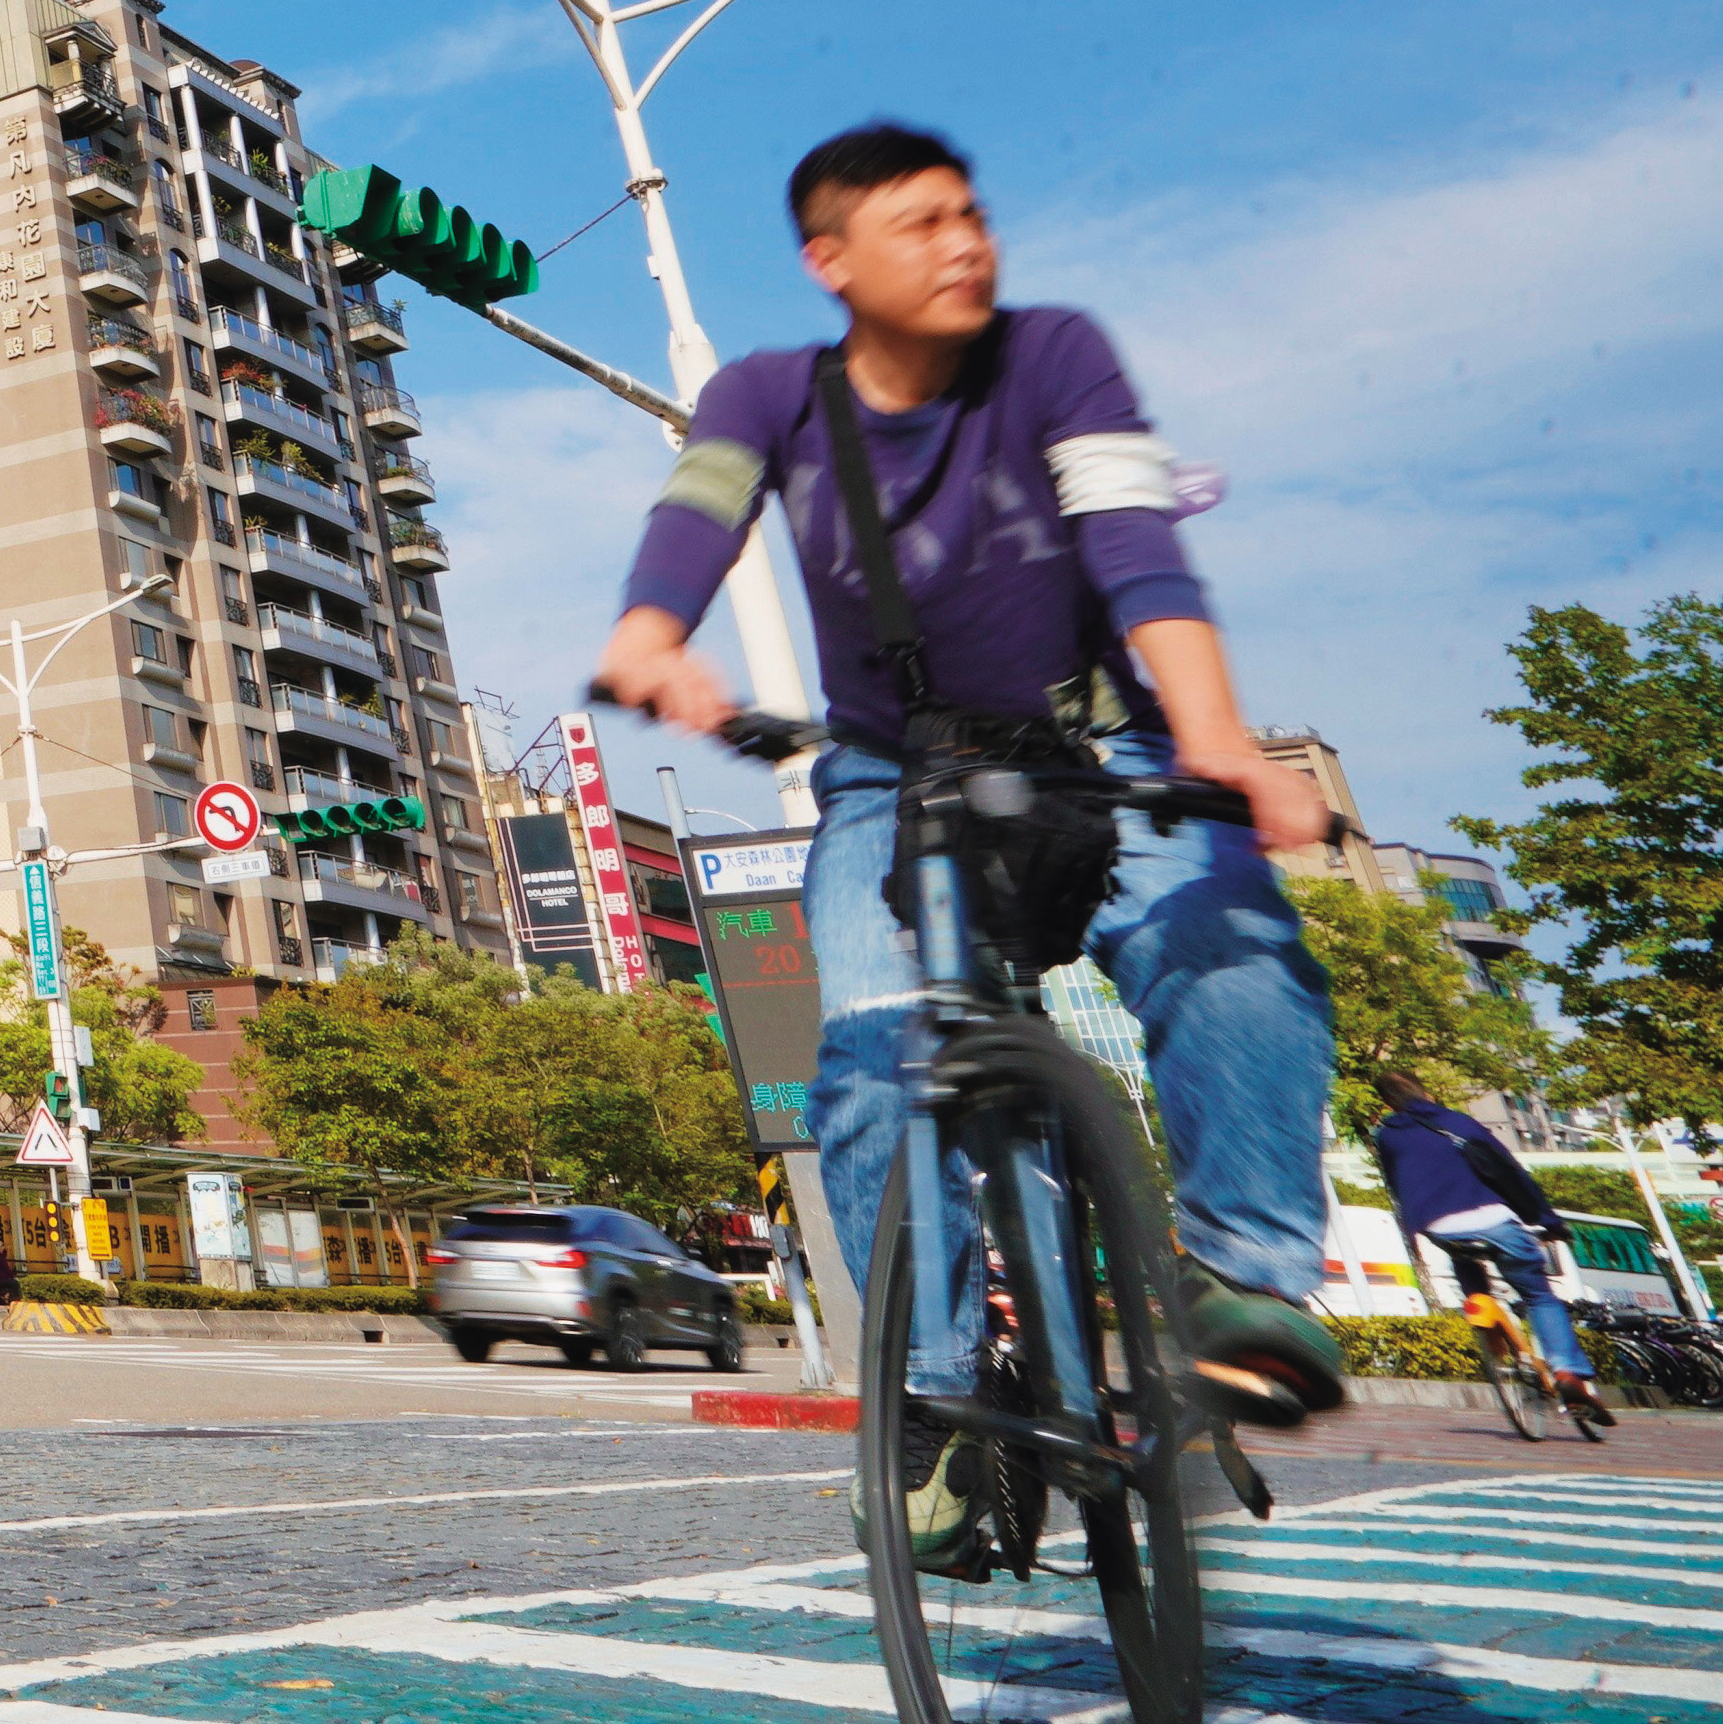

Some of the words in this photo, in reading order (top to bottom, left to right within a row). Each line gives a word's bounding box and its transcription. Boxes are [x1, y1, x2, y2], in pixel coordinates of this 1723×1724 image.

[575, 761, 629, 916] 多郎明哥
[724, 845, 811, 868] 大安森林公園地
[526, 886, 577, 898] DOLAMANCO
[746, 874, 776, 886] Daan
[787, 870, 804, 884] Ca
[29, 875, 50, 953] 信義路三段
[541, 898, 569, 907] HOTEL
[717, 908, 777, 940] 汽車
[789, 900, 809, 939] 1
[755, 943, 801, 974] 20
[750, 1082, 806, 1112] 身障
[21, 1217, 47, 1248] 5台
